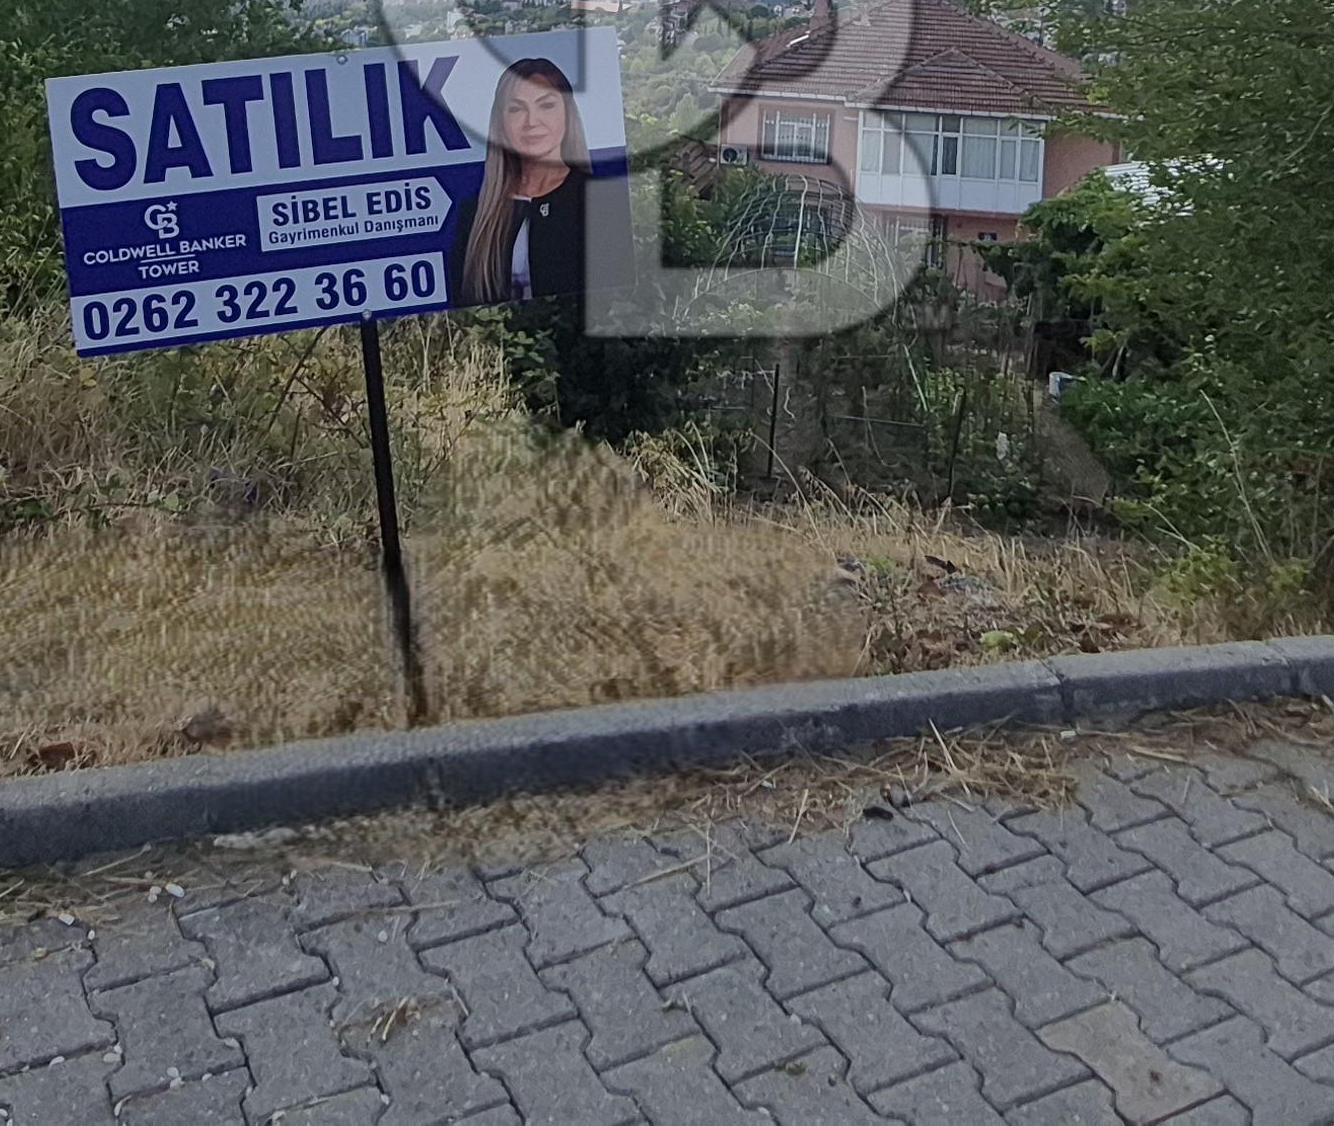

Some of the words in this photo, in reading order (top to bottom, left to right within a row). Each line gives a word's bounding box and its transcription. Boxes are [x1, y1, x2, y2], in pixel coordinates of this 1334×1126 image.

[70, 55, 472, 192] SATILIK
[272, 185, 357, 227] SİBEL
[366, 182, 432, 216] EDİS
[83, 243, 176, 265] COLDWELL
[179, 234, 247, 254] BANKER
[268, 223, 359, 246] Gayrimenkul
[364, 215, 439, 233] Danışmanı
[138, 260, 199, 280] TOWER
[83, 290, 199, 341] 0262
[215, 277, 299, 323] 322
[315, 268, 368, 311] 36
[384, 260, 436, 302] 60
